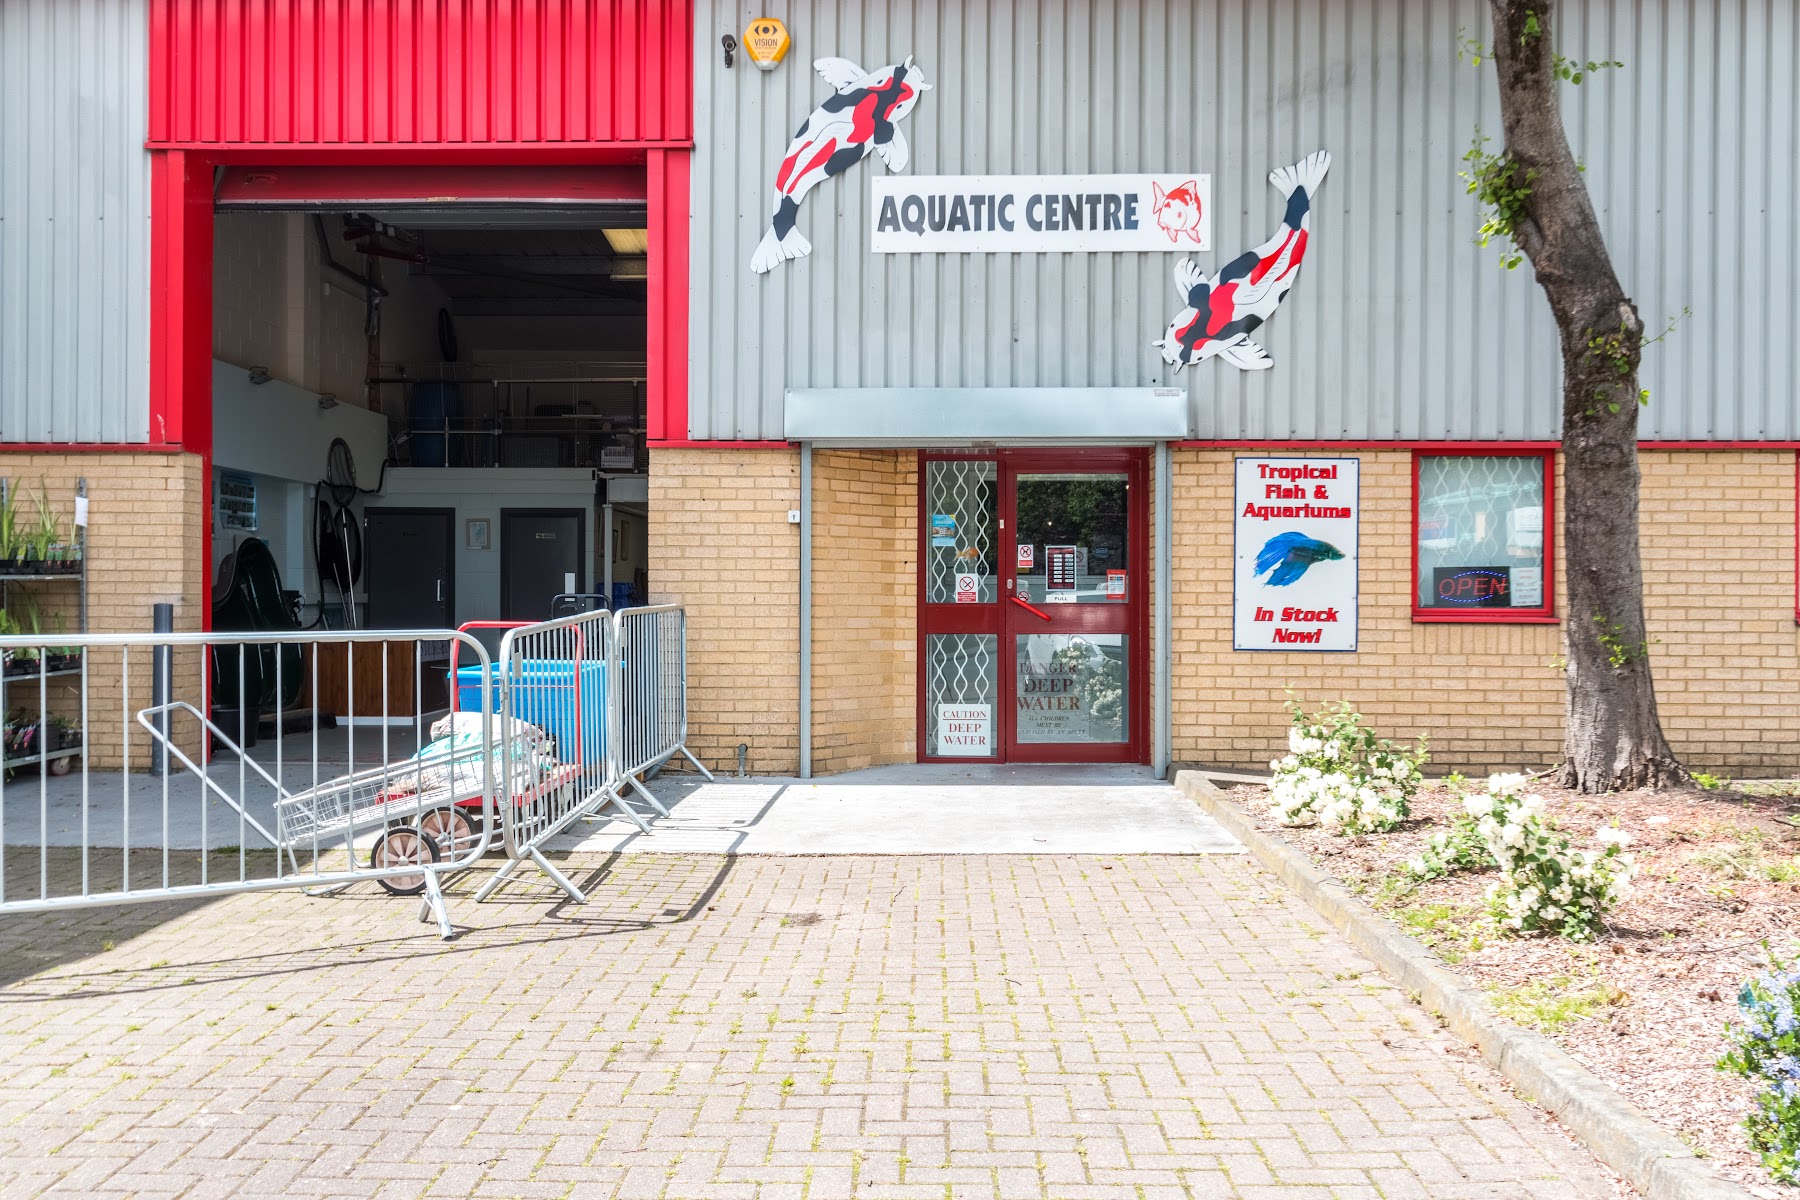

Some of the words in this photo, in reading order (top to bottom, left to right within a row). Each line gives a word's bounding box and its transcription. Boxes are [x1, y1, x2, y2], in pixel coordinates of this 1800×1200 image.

[754, 38, 777, 47] VISION
[877, 194, 1015, 237] AQUATIC
[1025, 193, 1139, 232] CENTRE
[1257, 464, 1337, 482] Tropical
[1265, 484, 1306, 499] Fish
[1313, 484, 1329, 500] &
[1242, 502, 1352, 521] Aquariums
[1439, 577, 1507, 596] OPEN
[1254, 607, 1274, 622] In
[1280, 606, 1339, 622] Stock
[1272, 628, 1322, 643] Now!
[1019, 662, 1077, 675] DANGER
[1024, 678, 1074, 693] DEEP
[1017, 696, 1081, 711] WATER
[943, 710, 987, 719] CAUTION
[949, 723, 982, 733] DEEP
[943, 735, 986, 745] WATER
